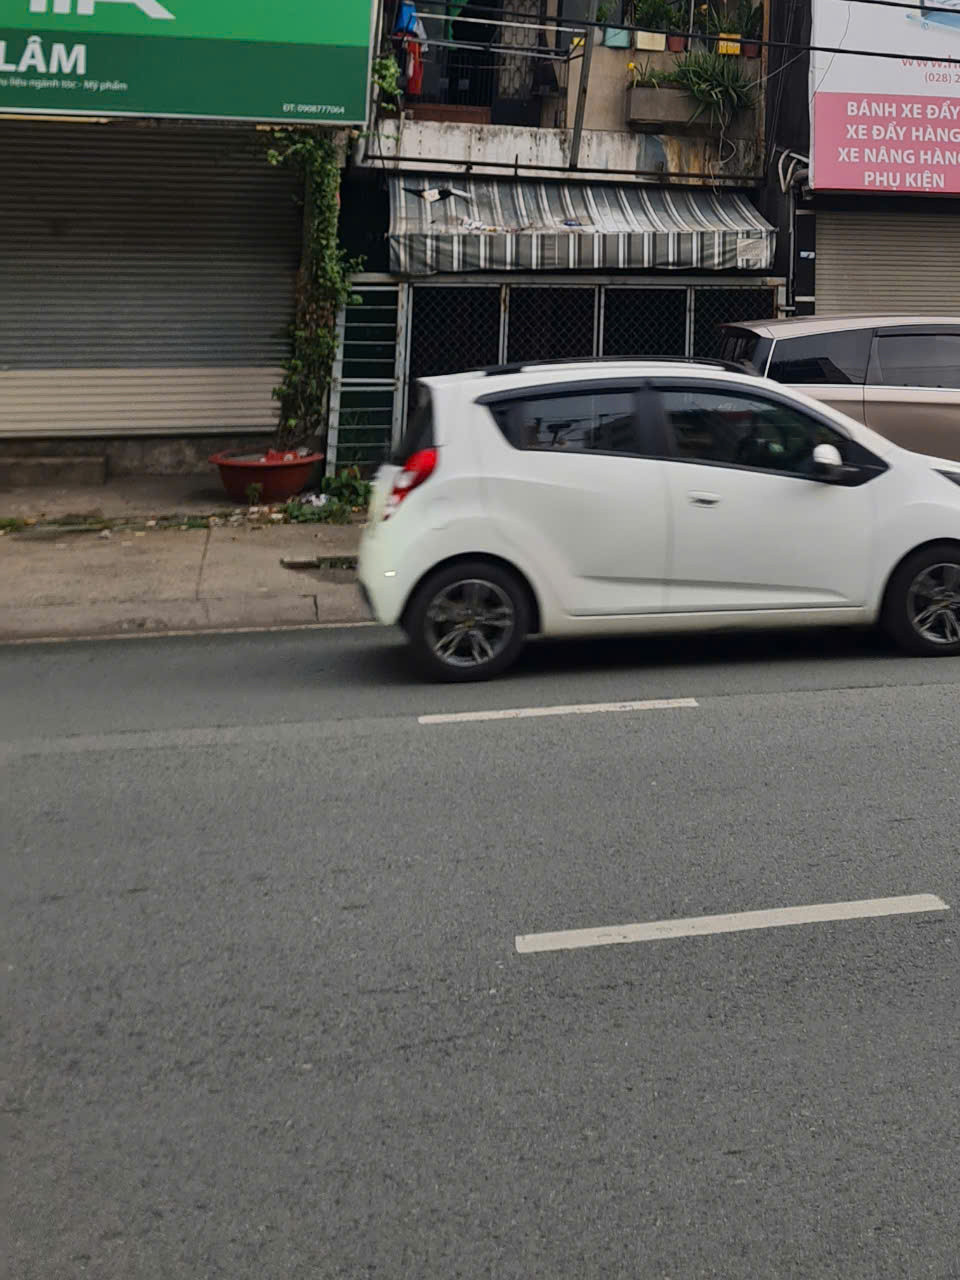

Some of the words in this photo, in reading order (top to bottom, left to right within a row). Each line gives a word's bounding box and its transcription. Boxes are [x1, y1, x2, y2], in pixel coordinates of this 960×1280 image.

[0, 35, 87, 75] LÂM
[925, 72, 952, 84] (028)
[847, 99, 897, 117] BÁNH
[901, 103, 923, 118] XE
[845, 124, 868, 140] XE
[838, 146, 860, 162] XE
[864, 145, 915, 164] NÂNG
[864, 171, 901, 190] PHỤ
[905, 169, 945, 191] KIỆN
